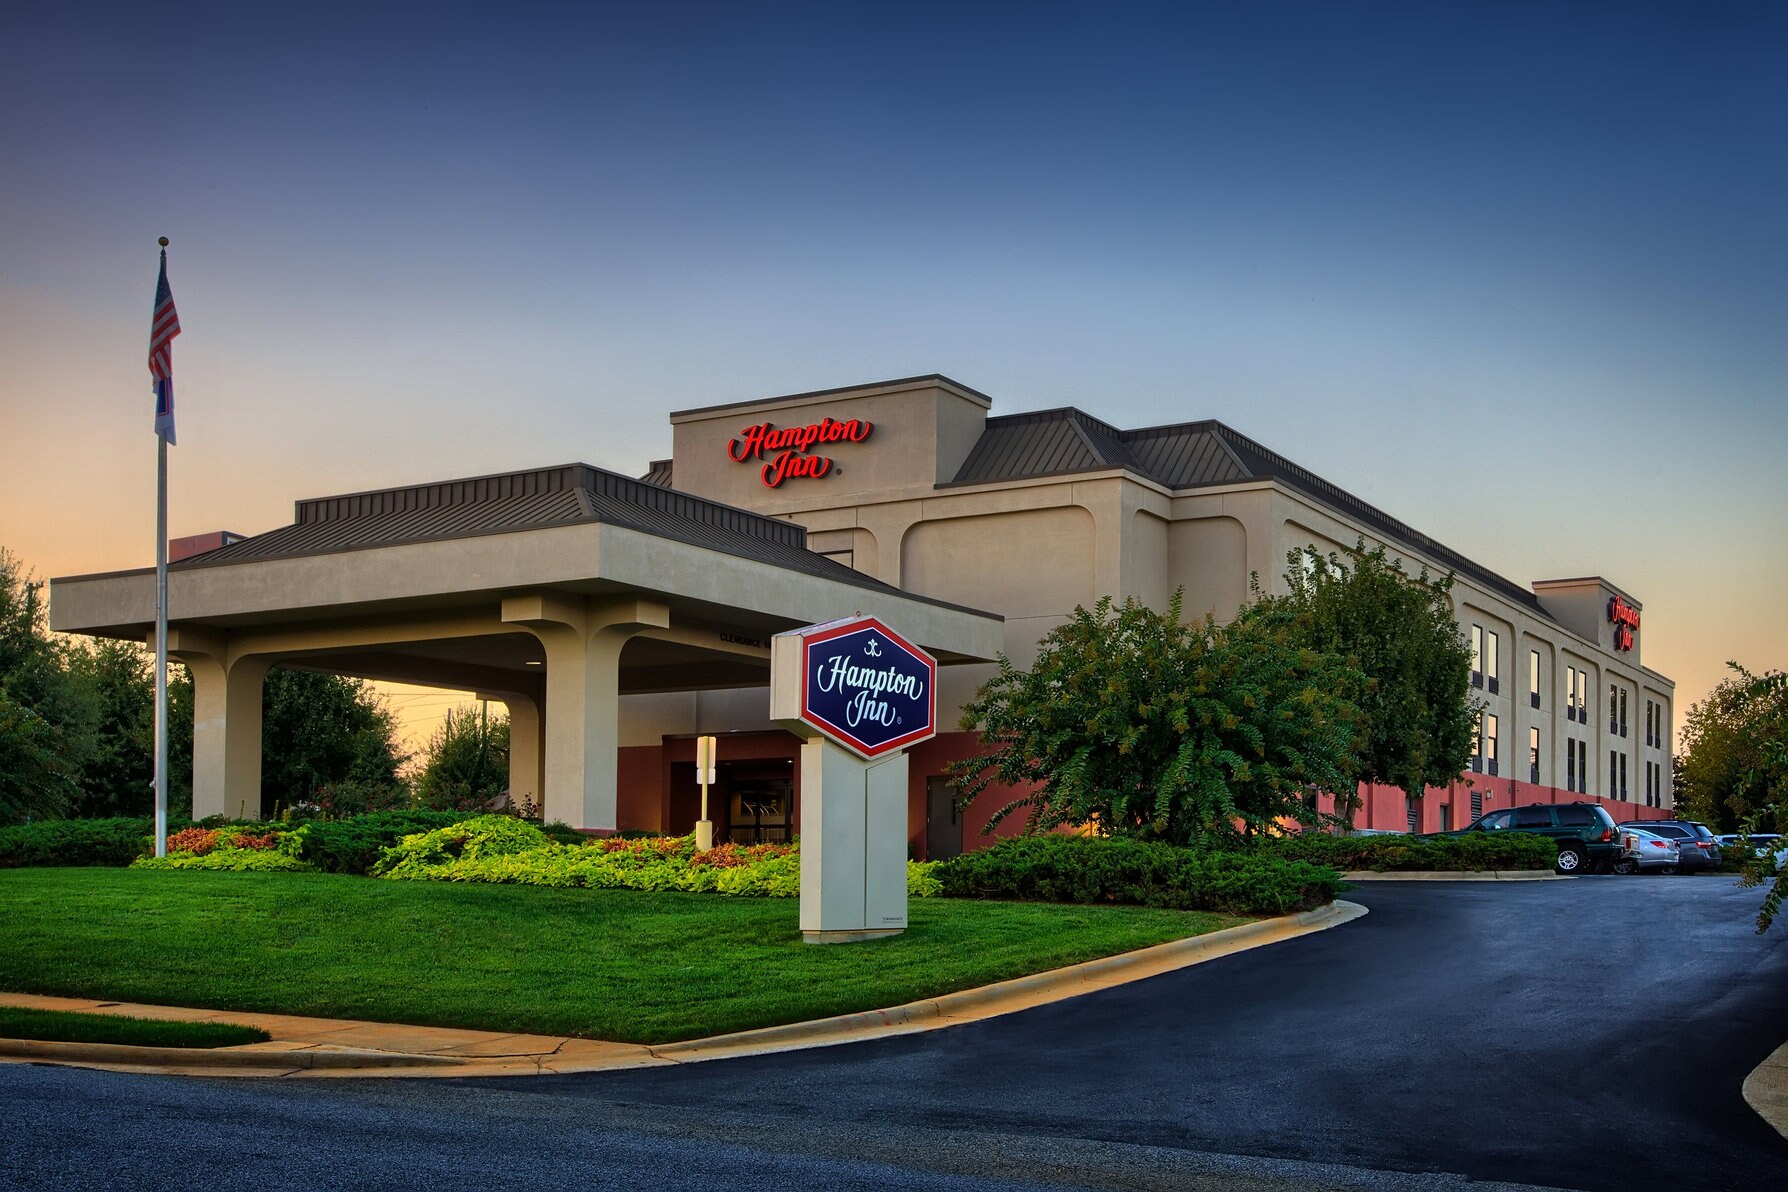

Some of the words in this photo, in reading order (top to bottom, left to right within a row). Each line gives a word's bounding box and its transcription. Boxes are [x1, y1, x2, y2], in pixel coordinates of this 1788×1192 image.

[728, 417, 874, 462] Hampton
[761, 450, 833, 488] Inn
[817, 655, 923, 700] Hampton
[846, 690, 896, 727] Inn
